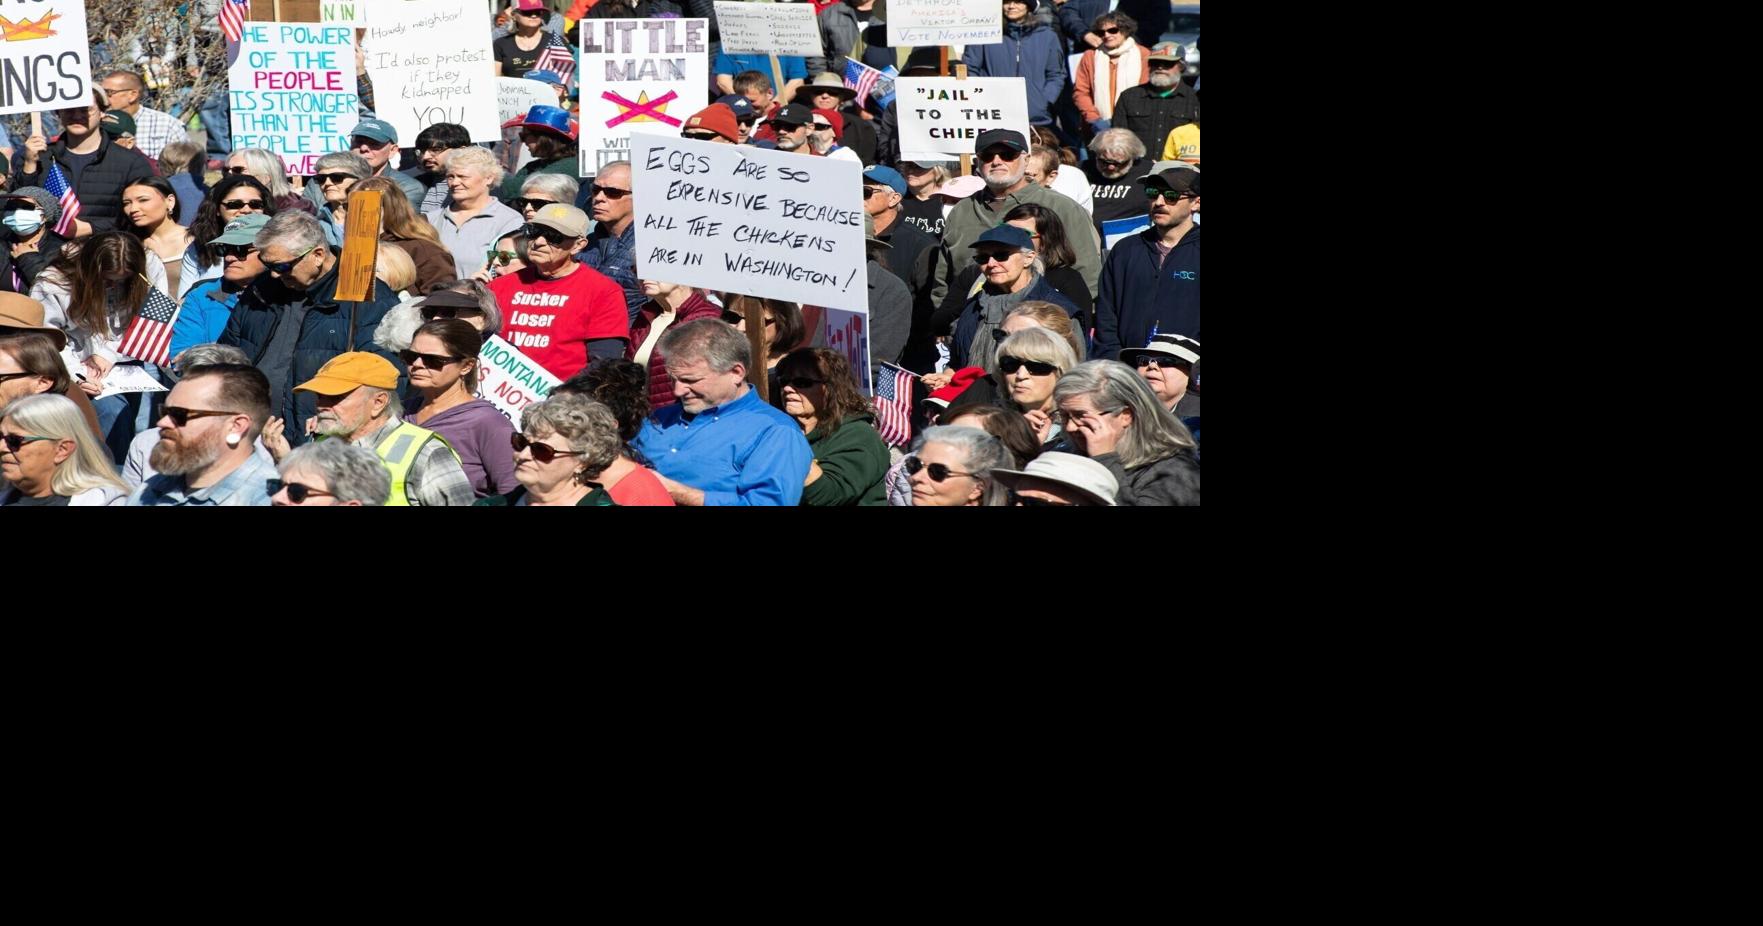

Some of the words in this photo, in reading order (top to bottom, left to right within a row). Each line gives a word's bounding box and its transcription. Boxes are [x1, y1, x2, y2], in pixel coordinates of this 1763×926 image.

[243, 26, 269, 43] HE
[280, 26, 351, 45] POWER
[371, 23, 406, 40] Howdy
[584, 20, 704, 53] LITTLE
[249, 51, 278, 68] OF
[288, 51, 337, 69] THE
[404, 51, 430, 67] also
[436, 48, 487, 68] protest
[0, 51, 83, 107] INGS
[410, 69, 422, 82] if
[428, 69, 461, 83] they
[605, 58, 686, 81] MAN
[255, 71, 343, 91] PEOPLE
[402, 78, 472, 100] kidnapped
[230, 90, 257, 111] IS
[262, 91, 358, 113] STRONGER
[236, 113, 289, 132] THAN
[292, 114, 338, 133] THE
[413, 106, 464, 131] YOU
[915, 109, 942, 120] TO
[960, 109, 1002, 120] THE
[233, 135, 312, 153] PEOPLE
[318, 136, 351, 153] IN
[603, 137, 631, 149] WIT
[646, 147, 711, 174] EGGS
[733, 158, 768, 181] ARE
[778, 167, 811, 182] SO
[666, 180, 769, 210] EXPENSIVE
[779, 199, 862, 227] BECAUSE
[644, 213, 677, 230] ALL
[686, 216, 722, 237] THE
[733, 225, 836, 253] CHICKENS
[648, 247, 678, 264] ARE
[683, 252, 703, 266] IN
[512, 291, 569, 307] Sucker
[510, 311, 555, 327] Loser
[514, 331, 550, 348] Vote
